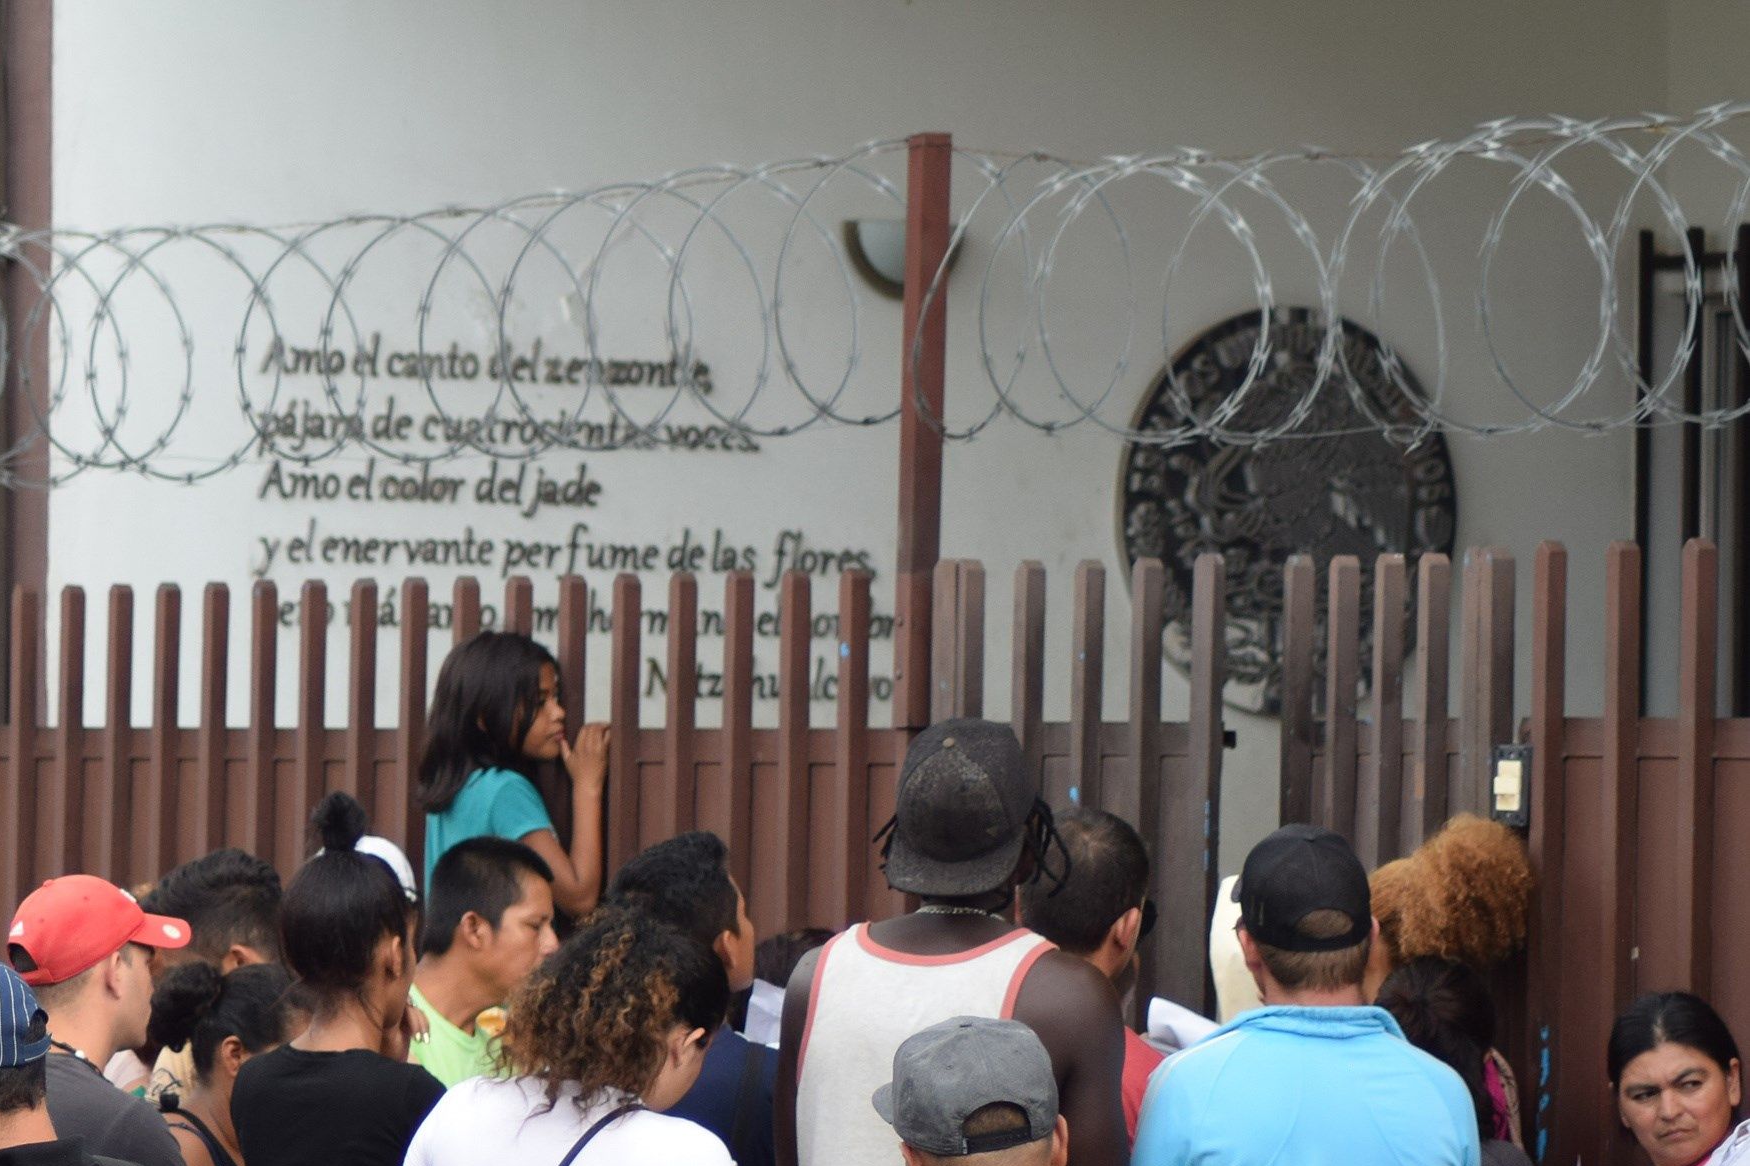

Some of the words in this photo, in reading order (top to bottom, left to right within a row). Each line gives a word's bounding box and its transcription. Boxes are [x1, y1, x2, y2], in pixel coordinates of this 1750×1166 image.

[259, 334, 346, 375] Amo
[352, 331, 381, 378] el
[387, 341, 480, 380] canto
[488, 336, 543, 384] del
[372, 394, 414, 441] de
[258, 458, 341, 500] Amo
[346, 457, 376, 501] el
[380, 459, 467, 502] color
[474, 460, 527, 506] del
[521, 462, 603, 519] jade
[251, 535, 281, 578] y
[286, 516, 317, 564] el
[320, 526, 495, 567] enervante
[501, 522, 661, 581] perfume
[666, 527, 706, 571] de
[711, 528, 758, 573] las
